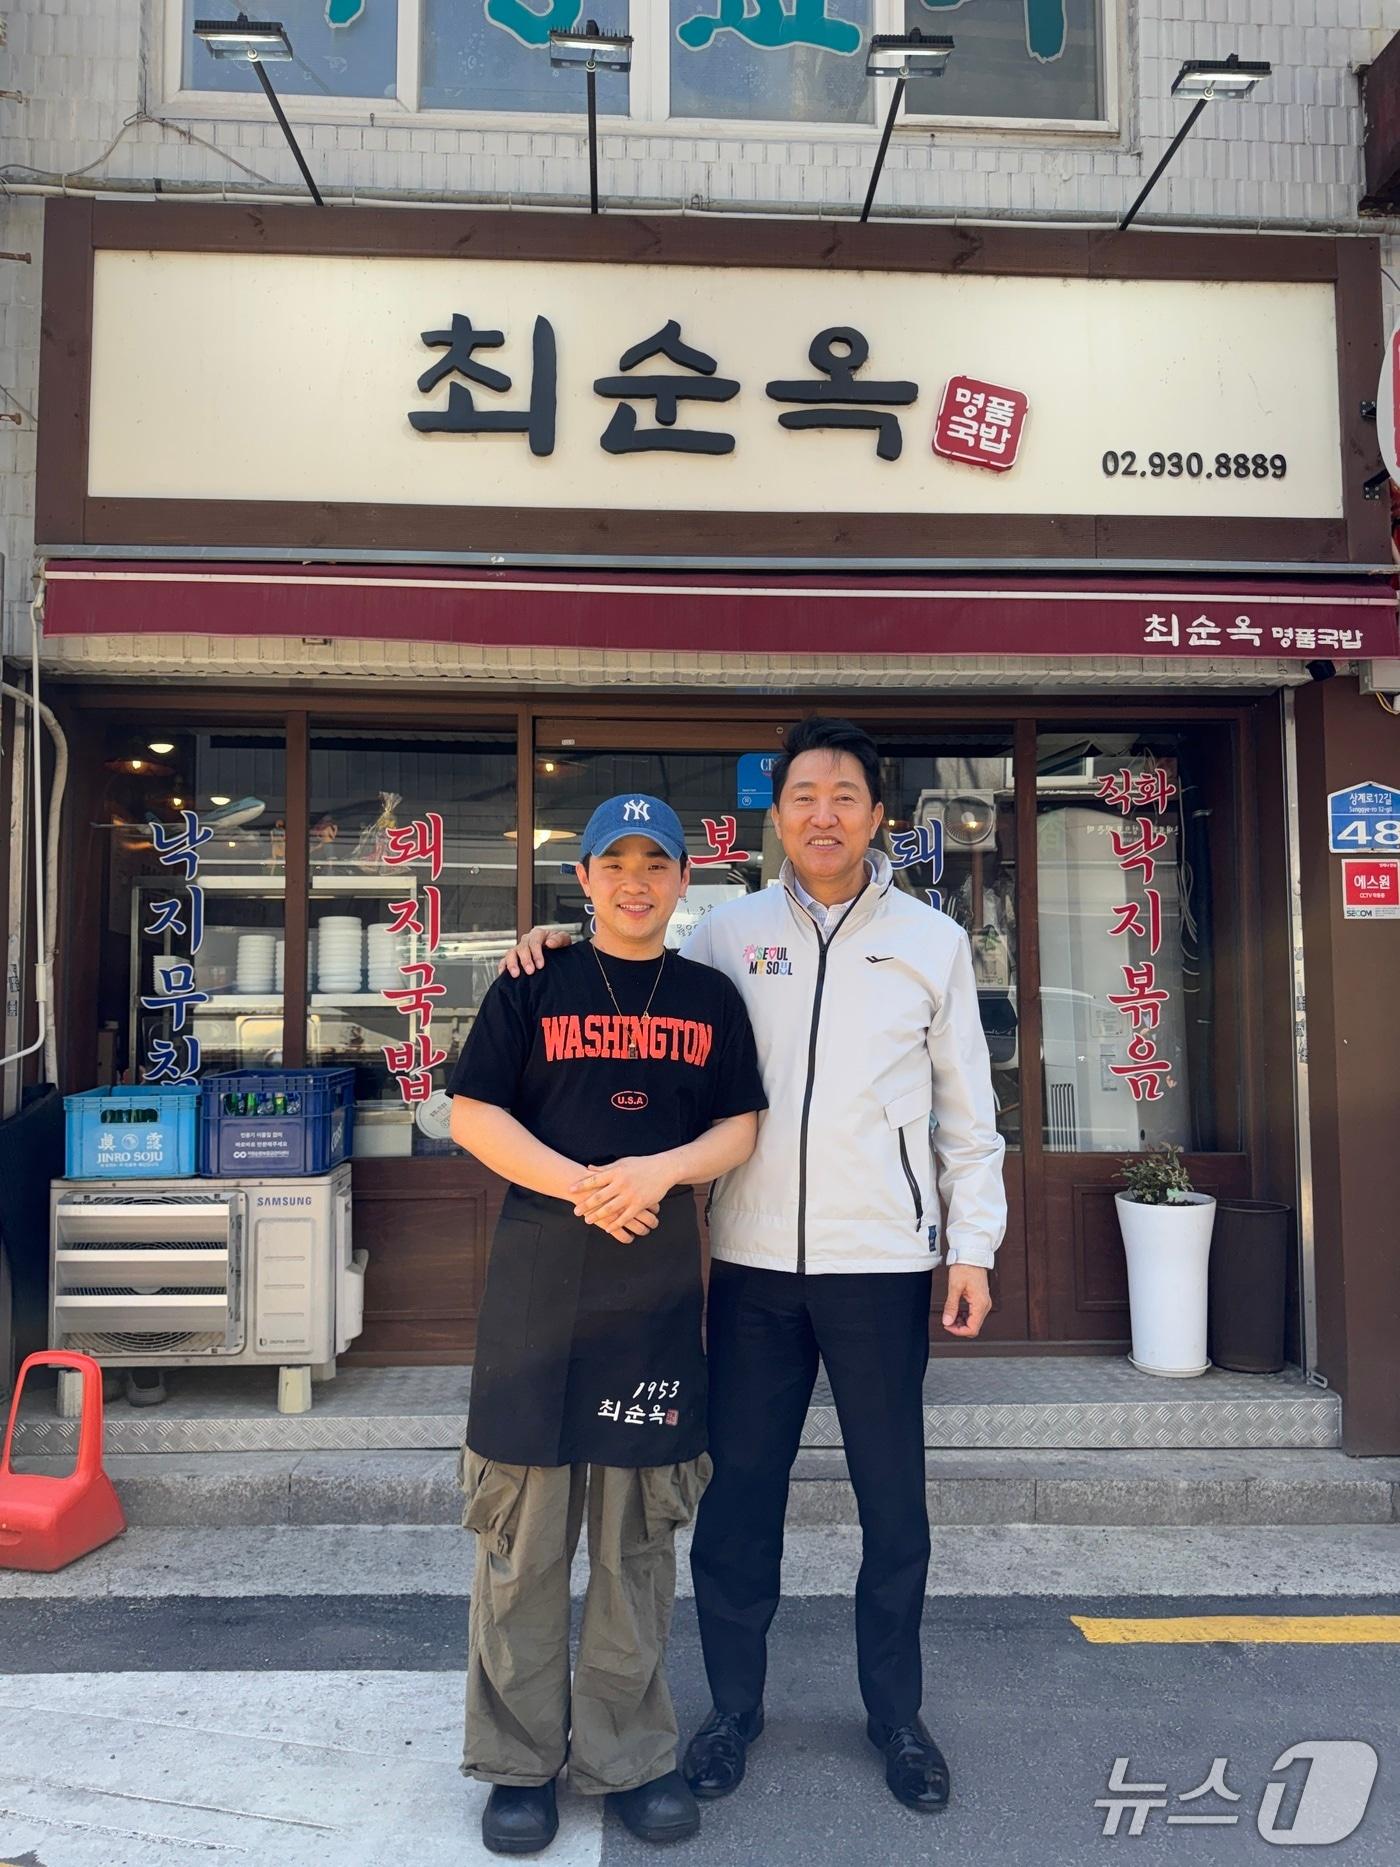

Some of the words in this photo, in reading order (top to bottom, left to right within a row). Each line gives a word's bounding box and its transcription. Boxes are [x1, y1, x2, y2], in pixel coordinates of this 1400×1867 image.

[408, 313, 919, 458] 최순옥
[955, 387, 1016, 428] 명품
[946, 415, 1012, 455] 국밥
[1102, 450, 1288, 479] 02.930.8889
[1143, 613, 1264, 647] 최순옥
[1271, 626, 1364, 649] 명품국밥
[1095, 768, 1177, 815] 직화
[1349, 792, 1392, 806] 상계로12길
[623, 799, 651, 821] NY
[1336, 820, 1400, 845] 48
[1353, 874, 1391, 890] 에스원
[140, 810, 214, 1087] 낙지무침
[381, 812, 448, 1104] 돼지국밥
[1107, 817, 1172, 1101] 낙지볶음
[541, 1014, 713, 1067] WASHINGTON
[617, 1096, 644, 1105] U.S.A
[97, 1152, 131, 1164] JINRO
[133, 1151, 163, 1164] SOJU
[257, 1196, 312, 1207] SAMSUNG
[632, 1380, 680, 1400] 1953
[597, 1399, 666, 1425] 최순옥
